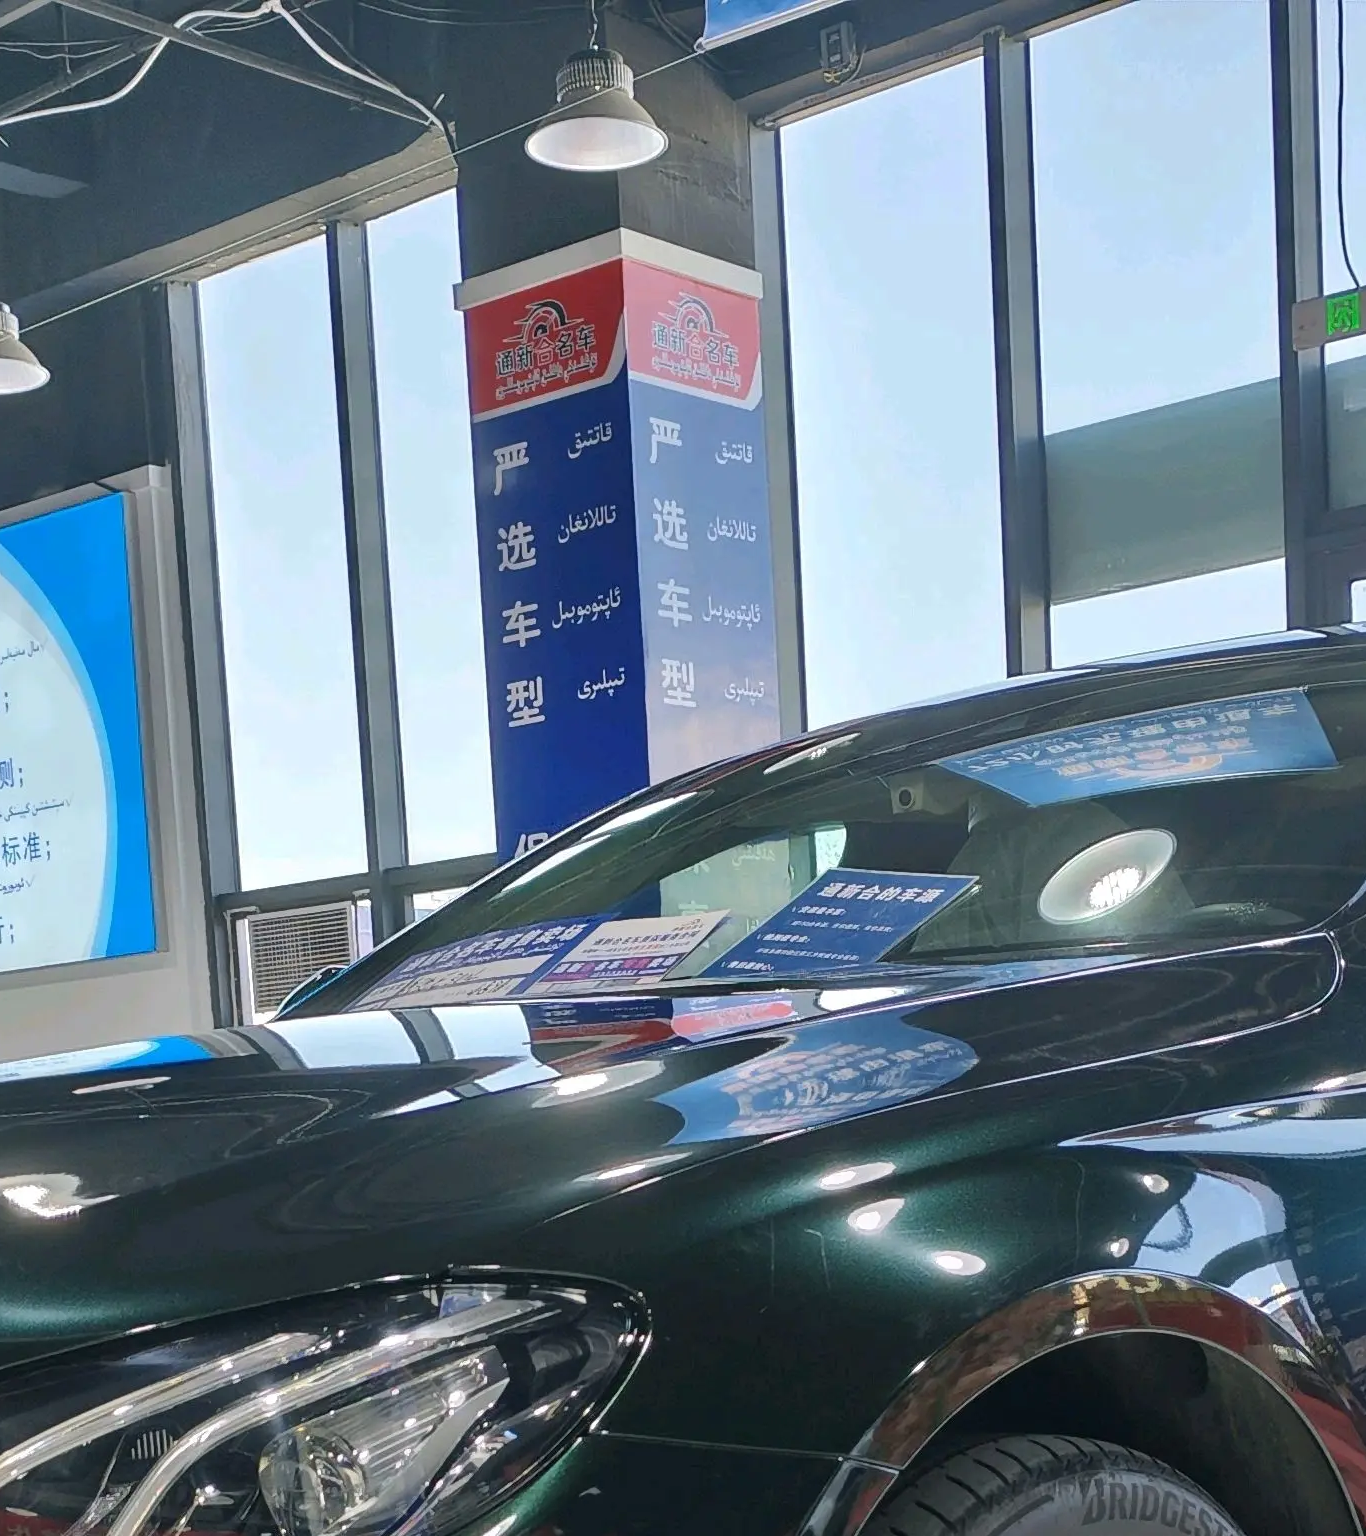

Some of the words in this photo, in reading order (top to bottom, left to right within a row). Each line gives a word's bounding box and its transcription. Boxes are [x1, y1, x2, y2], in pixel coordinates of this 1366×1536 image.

[496, 324, 596, 378] 通新合名车
[651, 321, 740, 367] 通新合名车
[493, 441, 546, 729] 严选车型
[648, 416, 697, 708] 严选车型
